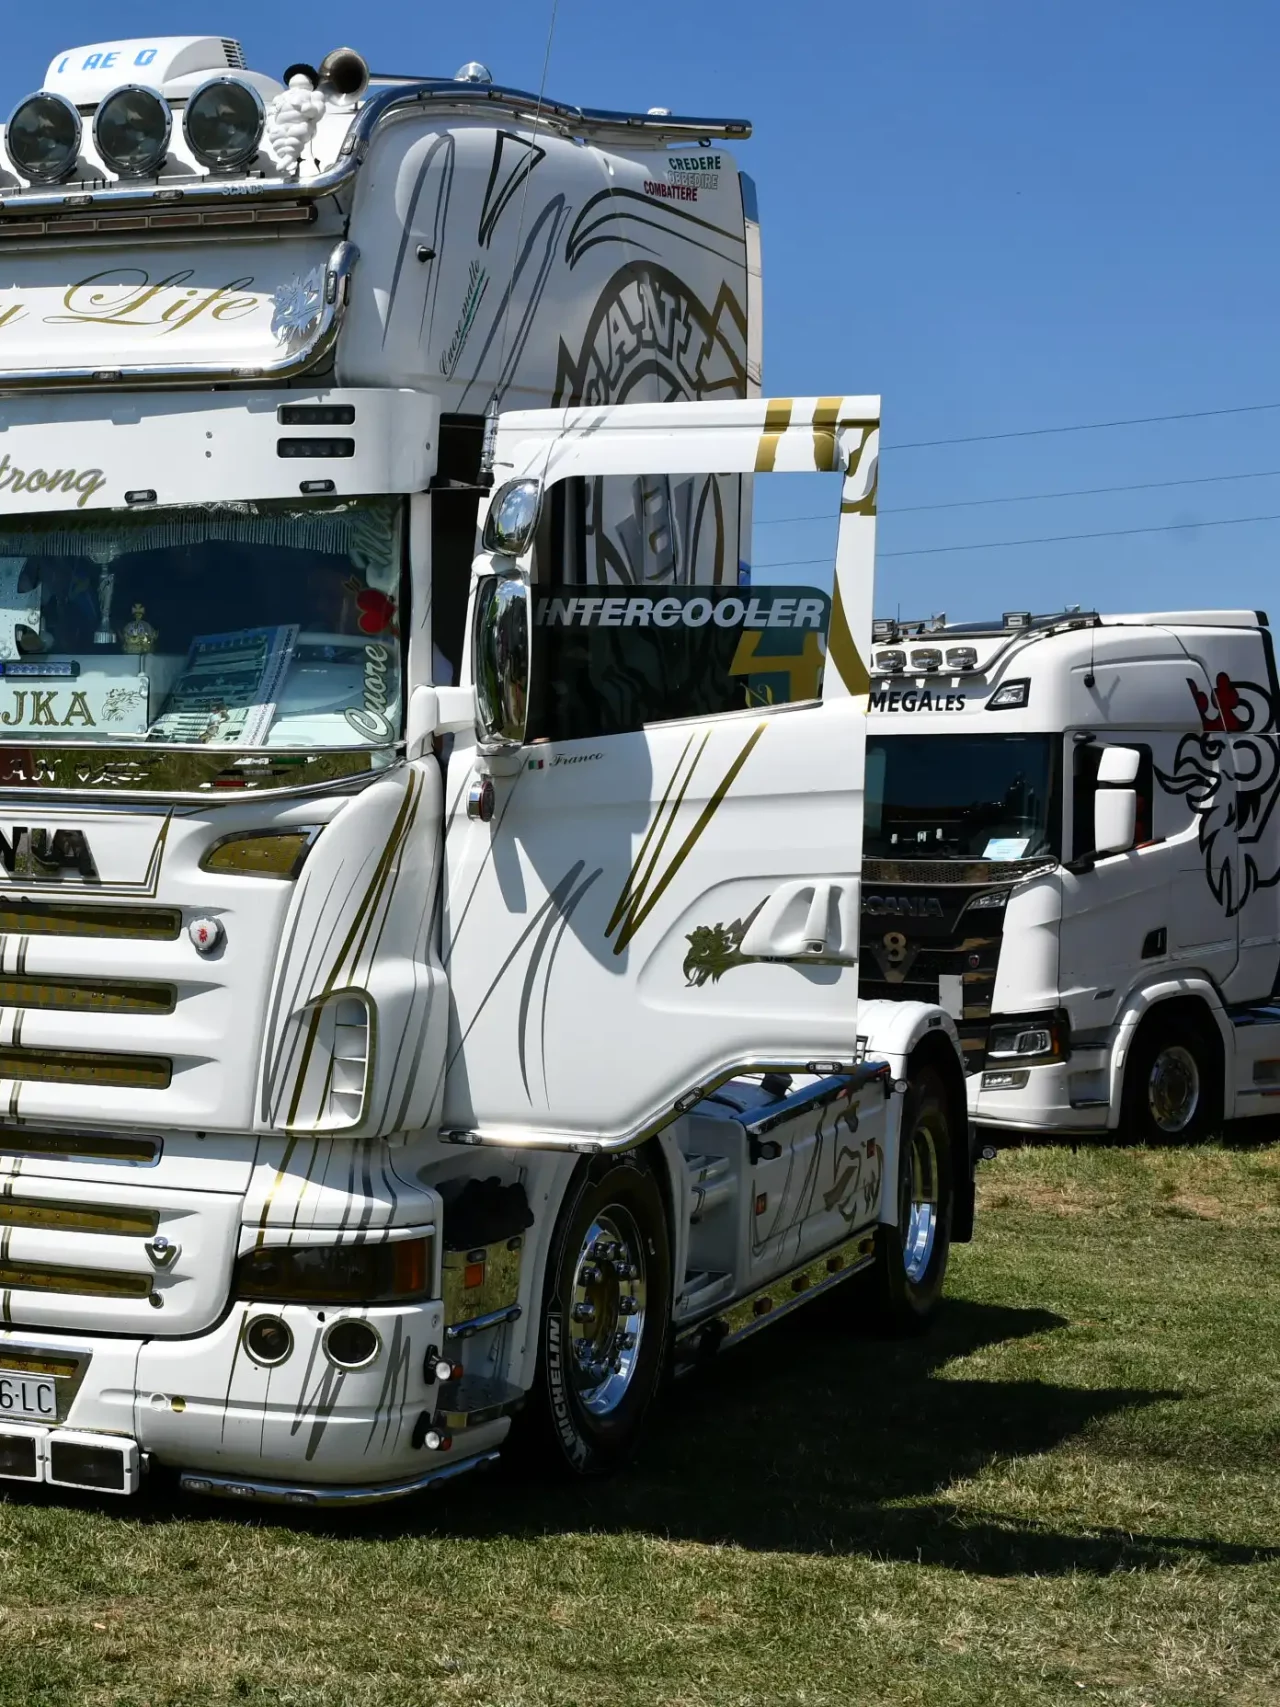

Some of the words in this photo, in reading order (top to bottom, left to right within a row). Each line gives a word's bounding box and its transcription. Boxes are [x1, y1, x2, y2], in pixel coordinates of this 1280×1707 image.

[668, 156, 721, 171] CREDERE
[221, 184, 265, 196] SCANIA
[643, 180, 698, 202] COMBATTERE
[667, 170, 719, 190] OBBEDIRE
[42, 267, 259, 338] Life
[534, 597, 826, 629] INTERCOOLER
[344, 642, 395, 744] Cuore
[549, 752, 605, 767] Franco
[548, 1316, 576, 1447] MICHELIN
